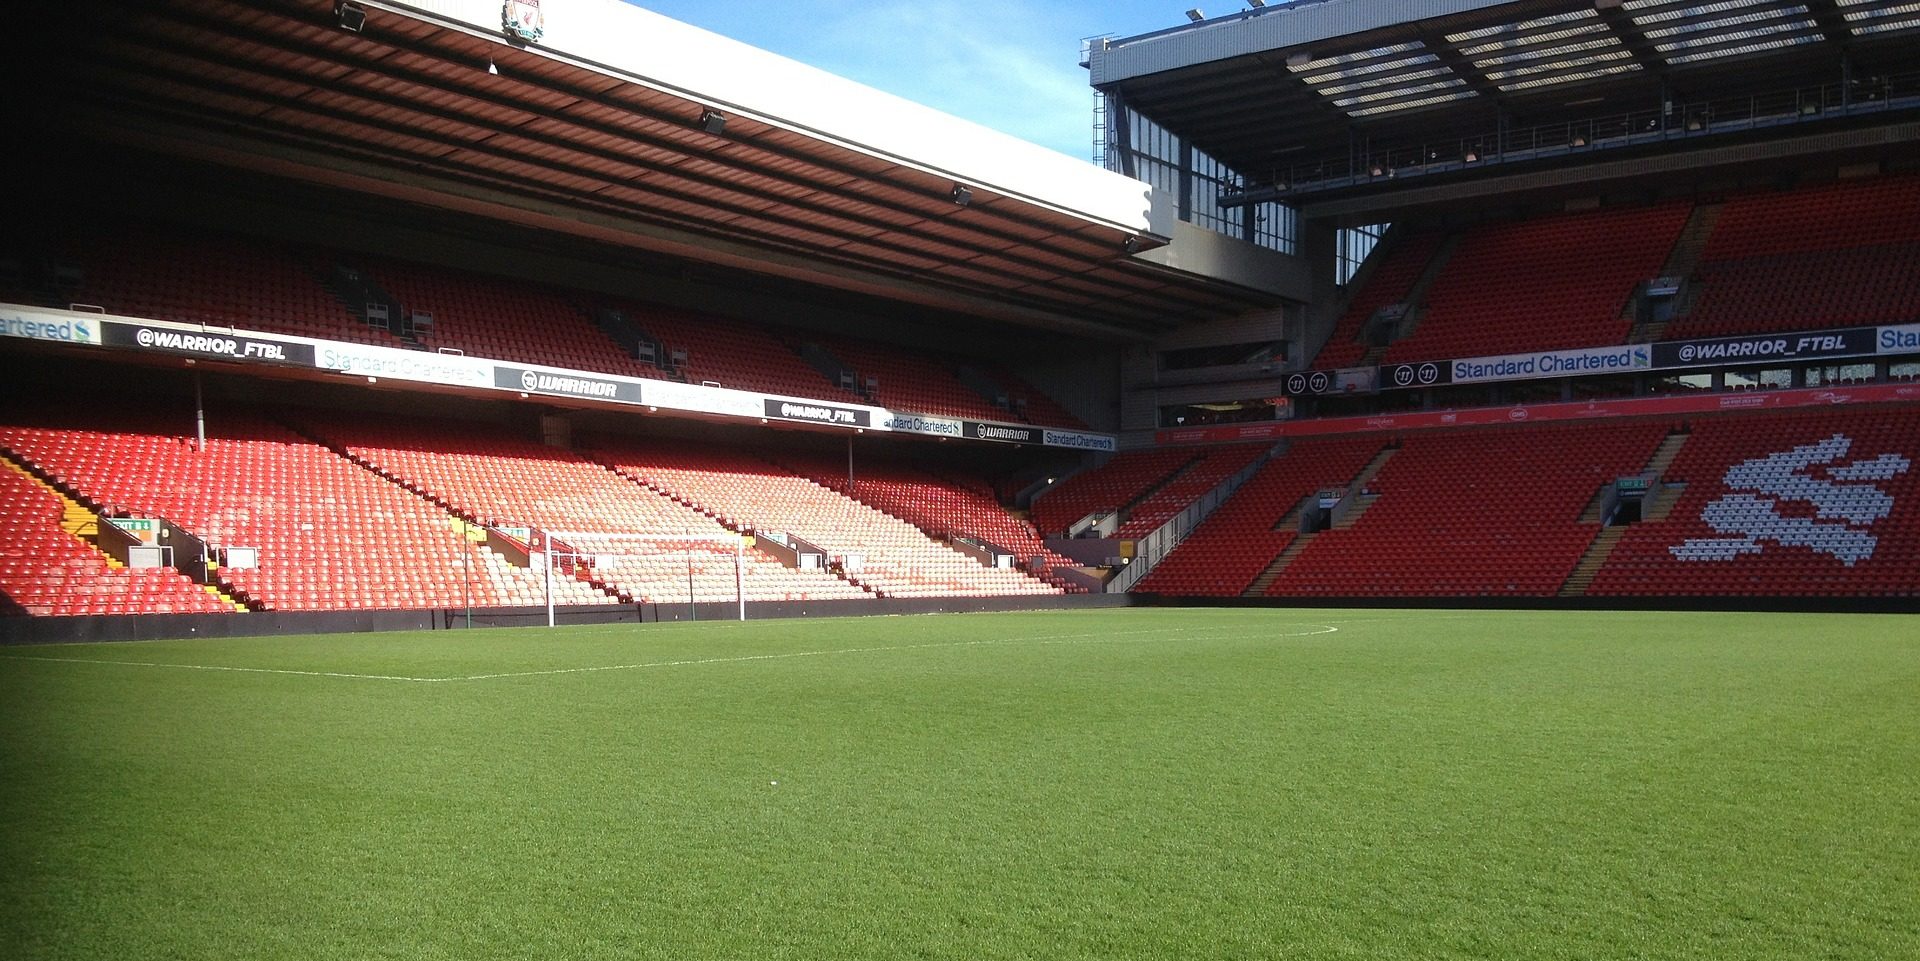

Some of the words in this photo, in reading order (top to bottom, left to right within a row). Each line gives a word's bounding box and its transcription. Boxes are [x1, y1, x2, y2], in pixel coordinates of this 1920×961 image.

[137, 329, 286, 360] @WARRIOR_FTBL
[1679, 335, 1847, 361] @WARRIOR_FTBL
[1880, 327, 1920, 349] Sta
[1454, 362, 1534, 378] Standard
[1541, 350, 1630, 372] Chartered
[538, 374, 617, 397] WARRIOR
[914, 418, 953, 433] Chartered
[986, 429, 1029, 441] WARRIOR
[1046, 432, 1076, 446] Standard
[1077, 435, 1107, 449] Chartered
